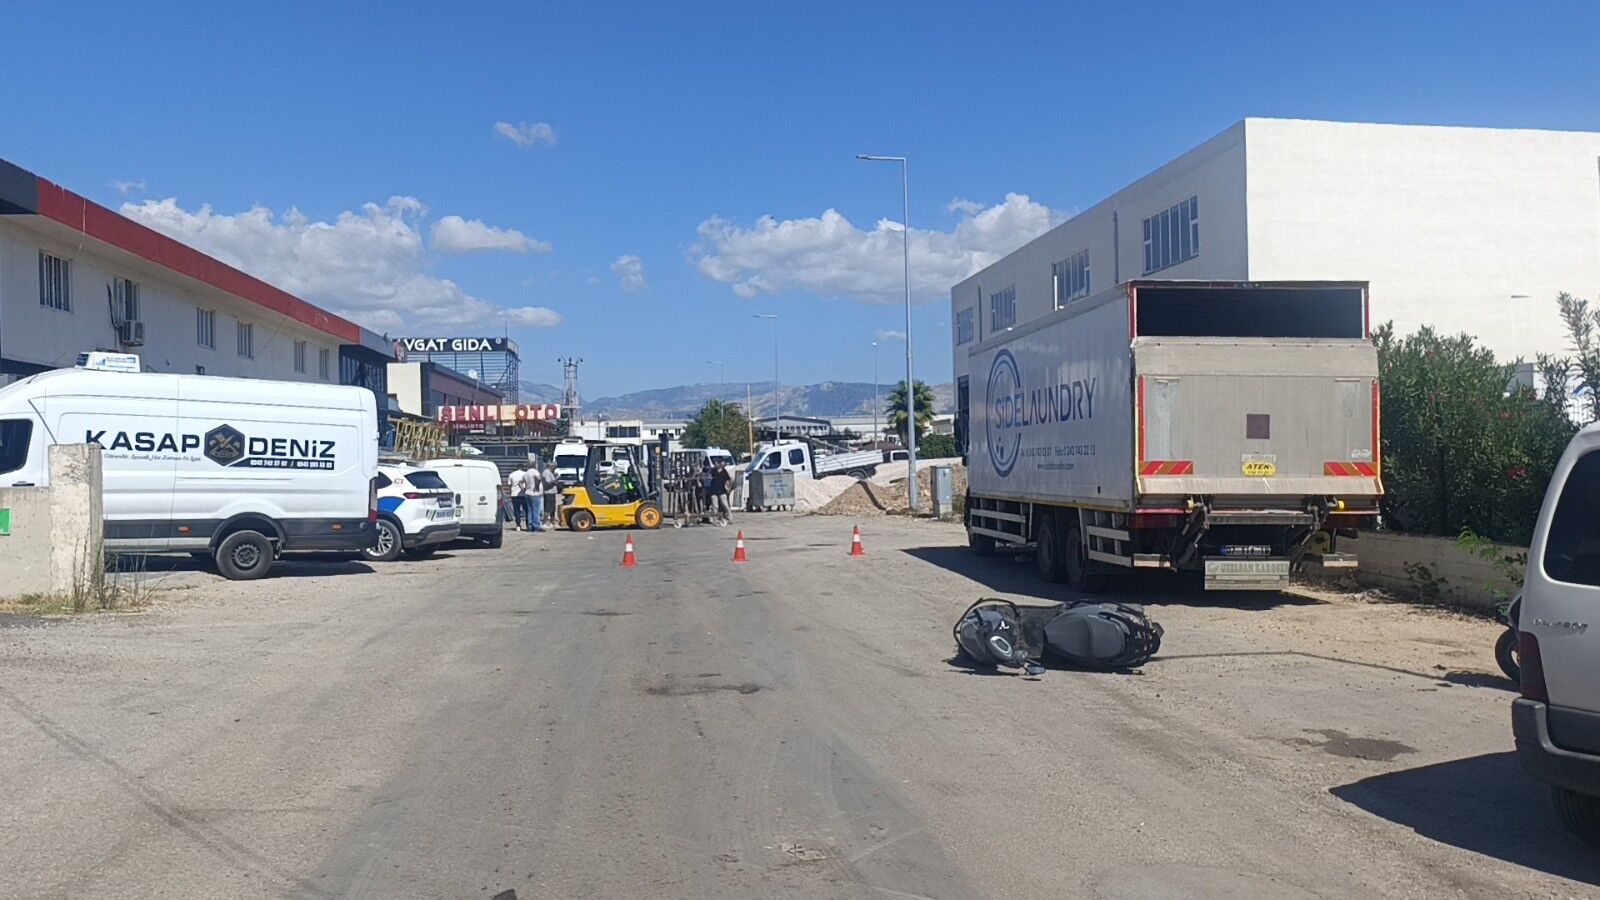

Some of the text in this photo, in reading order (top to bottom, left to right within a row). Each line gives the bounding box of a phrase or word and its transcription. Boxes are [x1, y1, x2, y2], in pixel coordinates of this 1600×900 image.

[451, 338, 492, 351] GIDA
[515, 404, 558, 421] OTO
[995, 377, 1096, 430] SIDELAUNDRY
[86, 429, 200, 453] KASAP
